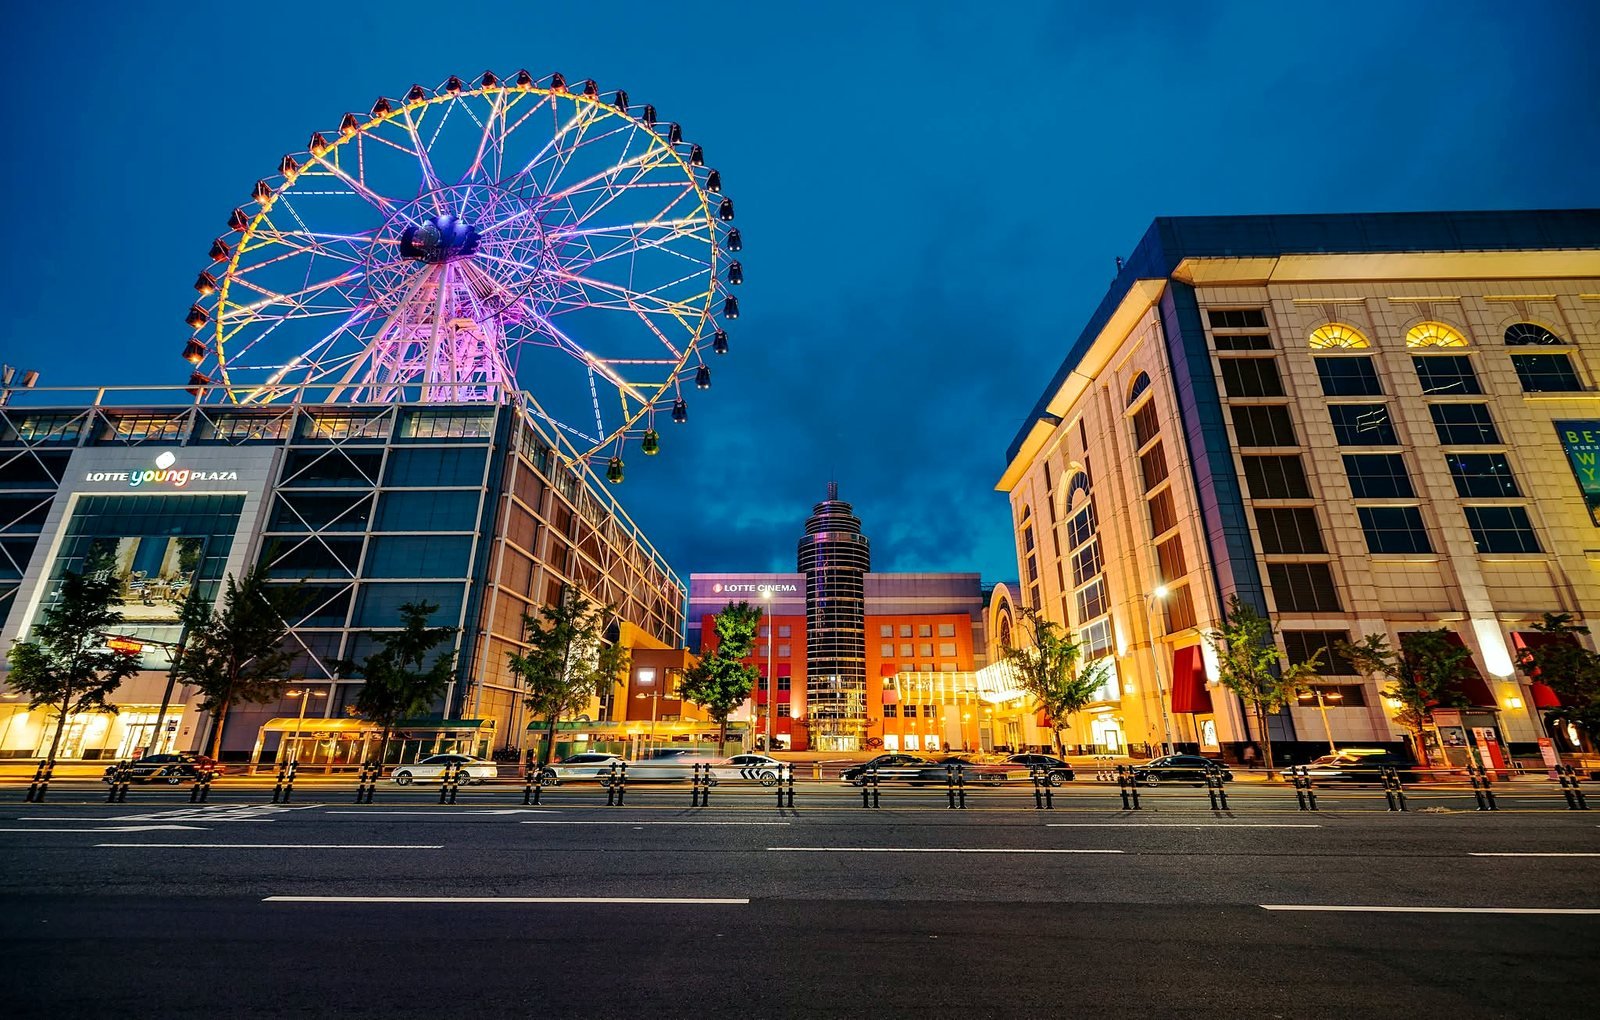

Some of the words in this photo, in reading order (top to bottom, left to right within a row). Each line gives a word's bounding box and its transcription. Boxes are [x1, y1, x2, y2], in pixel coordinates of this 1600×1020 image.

[86, 472, 129, 481] LOTTE
[129, 469, 190, 487] young
[191, 471, 238, 481] PLAZA
[724, 584, 756, 592] LOTTE
[757, 584, 797, 592] CINEMA
